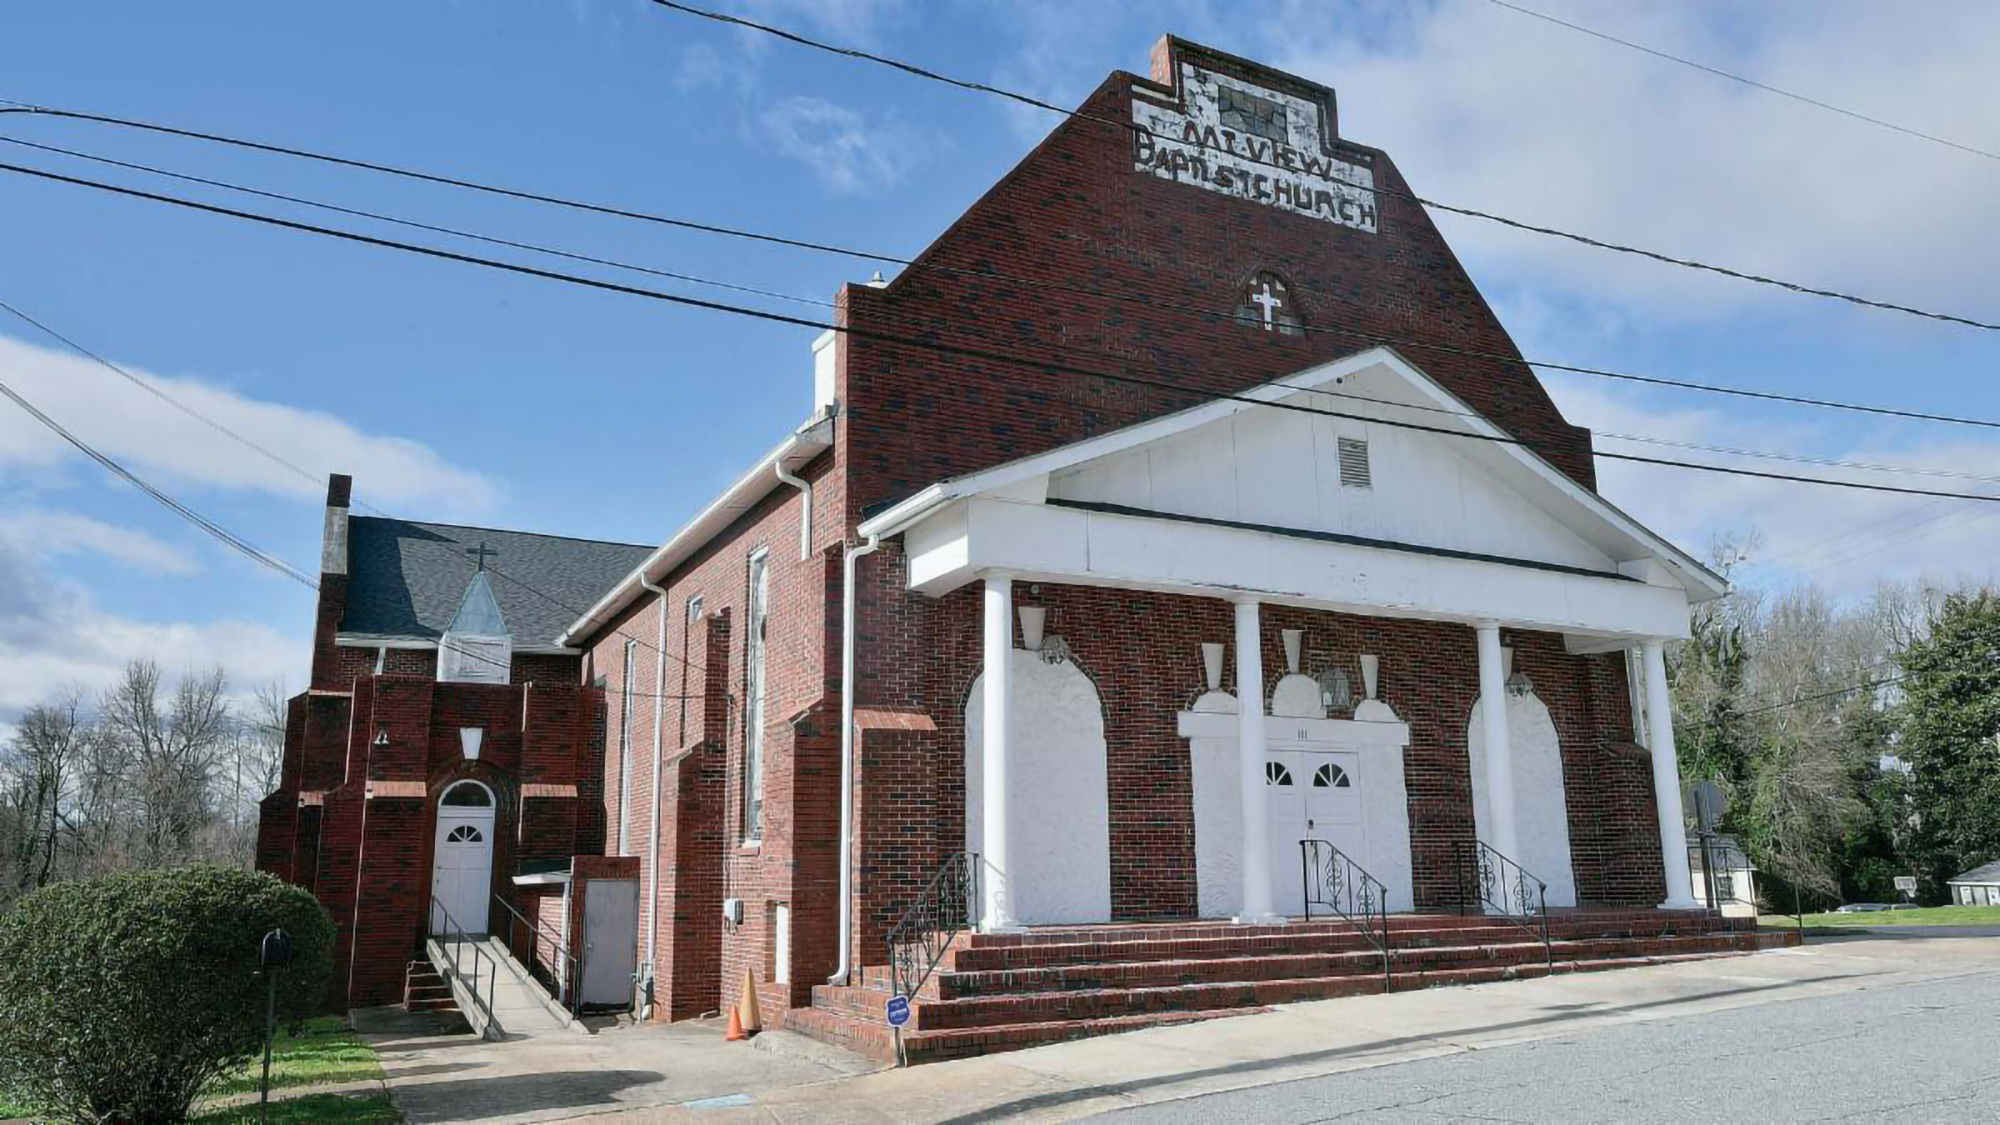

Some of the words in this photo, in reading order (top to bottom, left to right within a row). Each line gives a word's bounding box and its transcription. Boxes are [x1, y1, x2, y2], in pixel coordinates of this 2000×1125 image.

[1135, 124, 1252, 197] BAPTIST
[1253, 173, 1376, 227] CHURCH
[1246, 135, 1333, 181] VIEW
